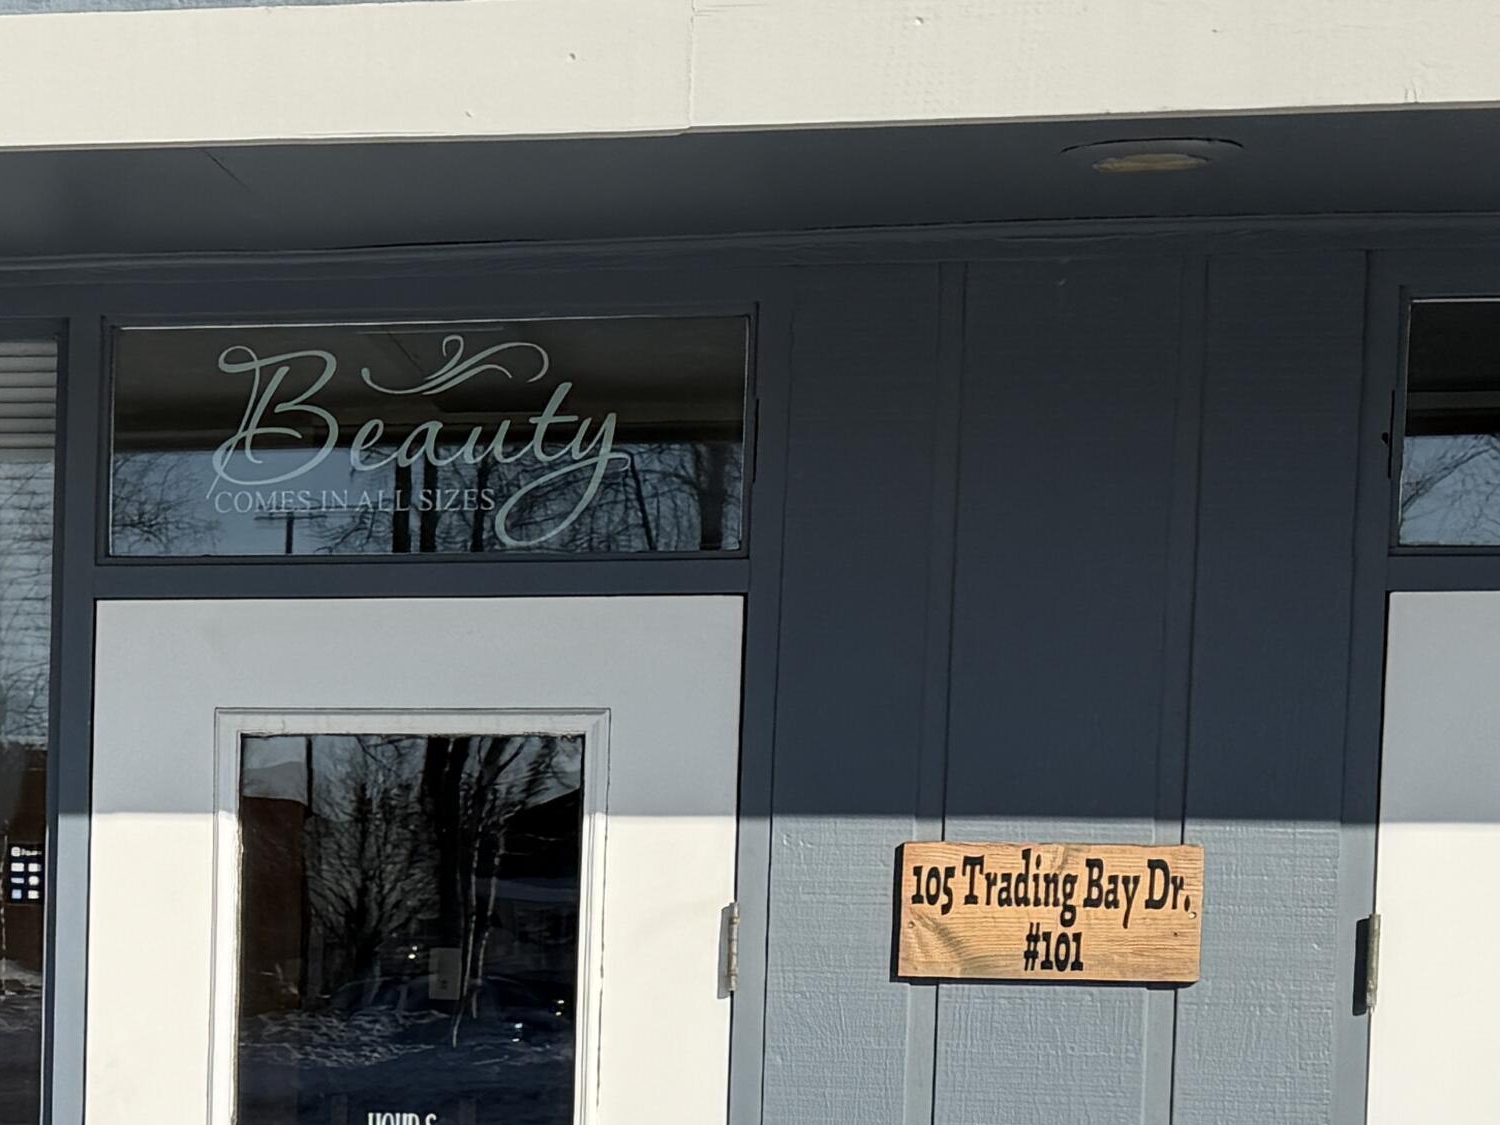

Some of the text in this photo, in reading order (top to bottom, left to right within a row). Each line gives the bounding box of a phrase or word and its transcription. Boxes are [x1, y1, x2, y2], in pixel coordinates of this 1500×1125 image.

[206, 346, 631, 549] Beauty
[214, 488, 495, 515] COMES IN ALL SIZES
[911, 848, 1191, 929] 105 Trading Bay Dr.
[1023, 922, 1085, 972] #101
